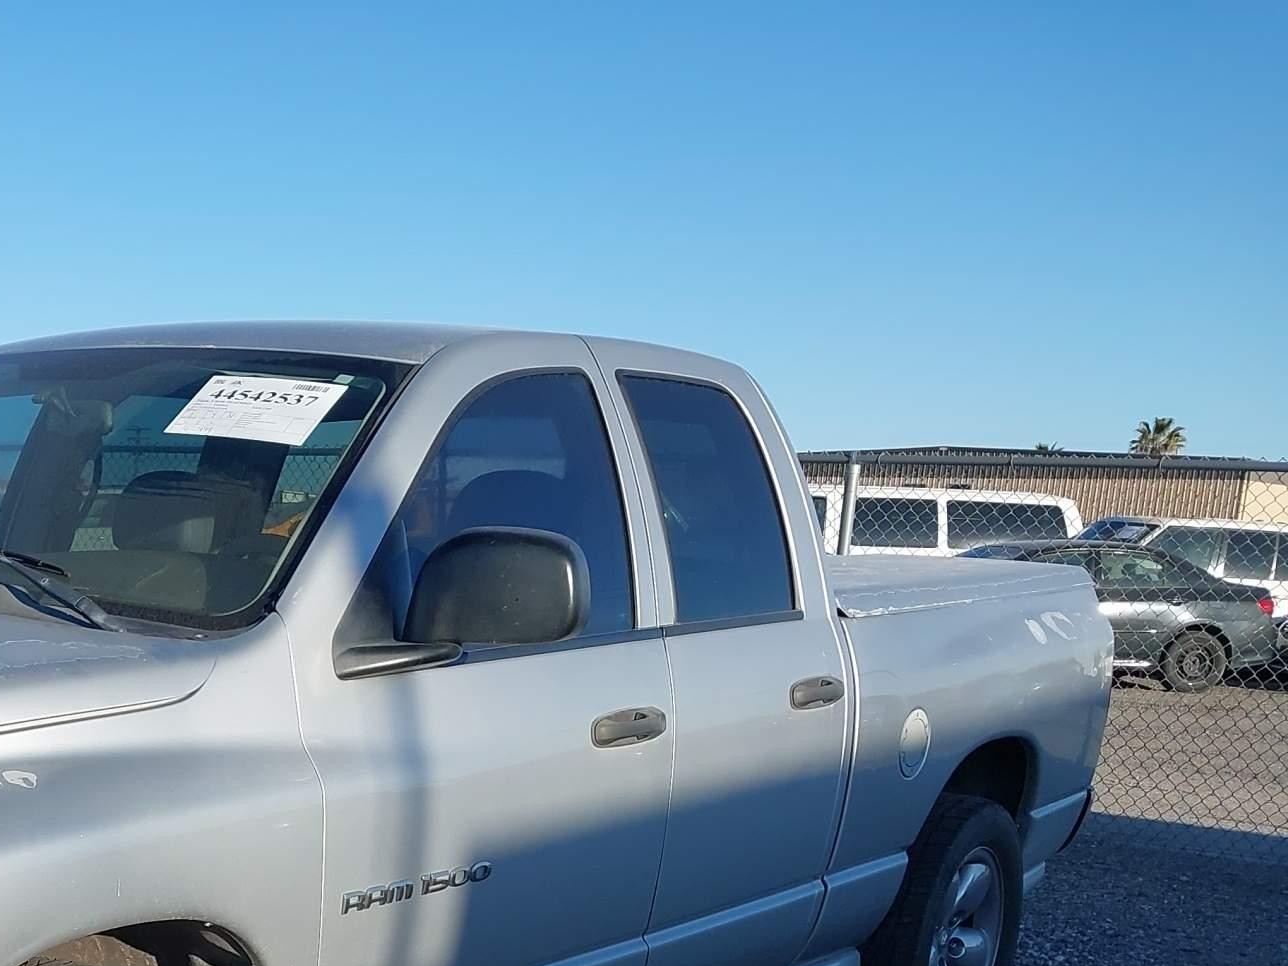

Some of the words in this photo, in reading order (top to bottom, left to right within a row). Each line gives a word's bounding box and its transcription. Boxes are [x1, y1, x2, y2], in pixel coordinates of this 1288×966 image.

[209, 388, 319, 407] 44542537
[340, 879, 415, 916] RAM
[420, 861, 493, 896] 1500
